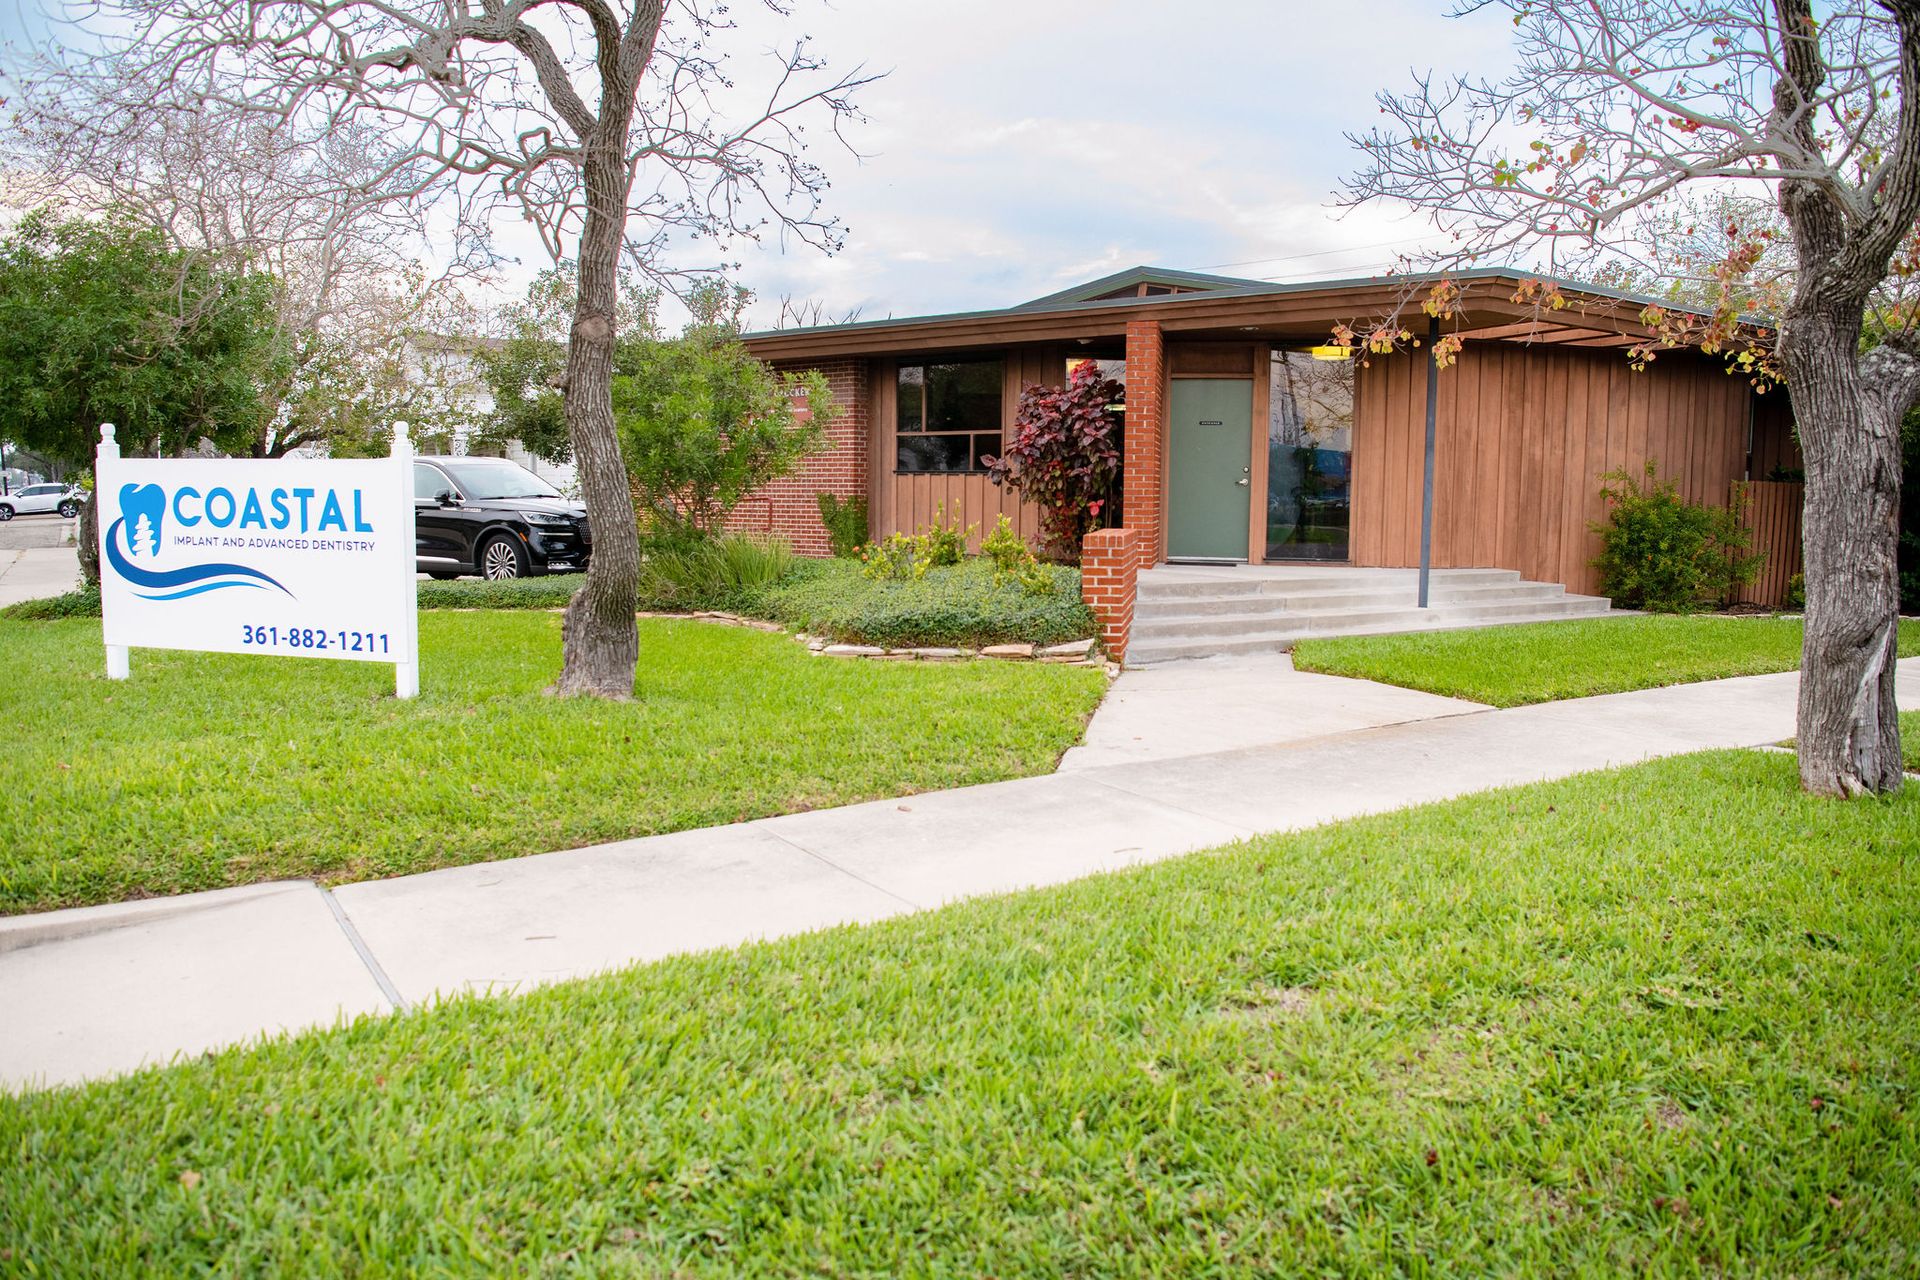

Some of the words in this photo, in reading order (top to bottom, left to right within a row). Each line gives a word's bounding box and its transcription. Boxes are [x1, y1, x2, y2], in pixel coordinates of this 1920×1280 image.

[172, 486, 374, 534] COASTAL
[173, 536, 219, 547] IMPLANT
[222, 537, 246, 548] AND
[248, 538, 310, 550] ADVANCED
[312, 540, 375, 551] DENTISTRY
[242, 624, 389, 653] 361-882-1211
